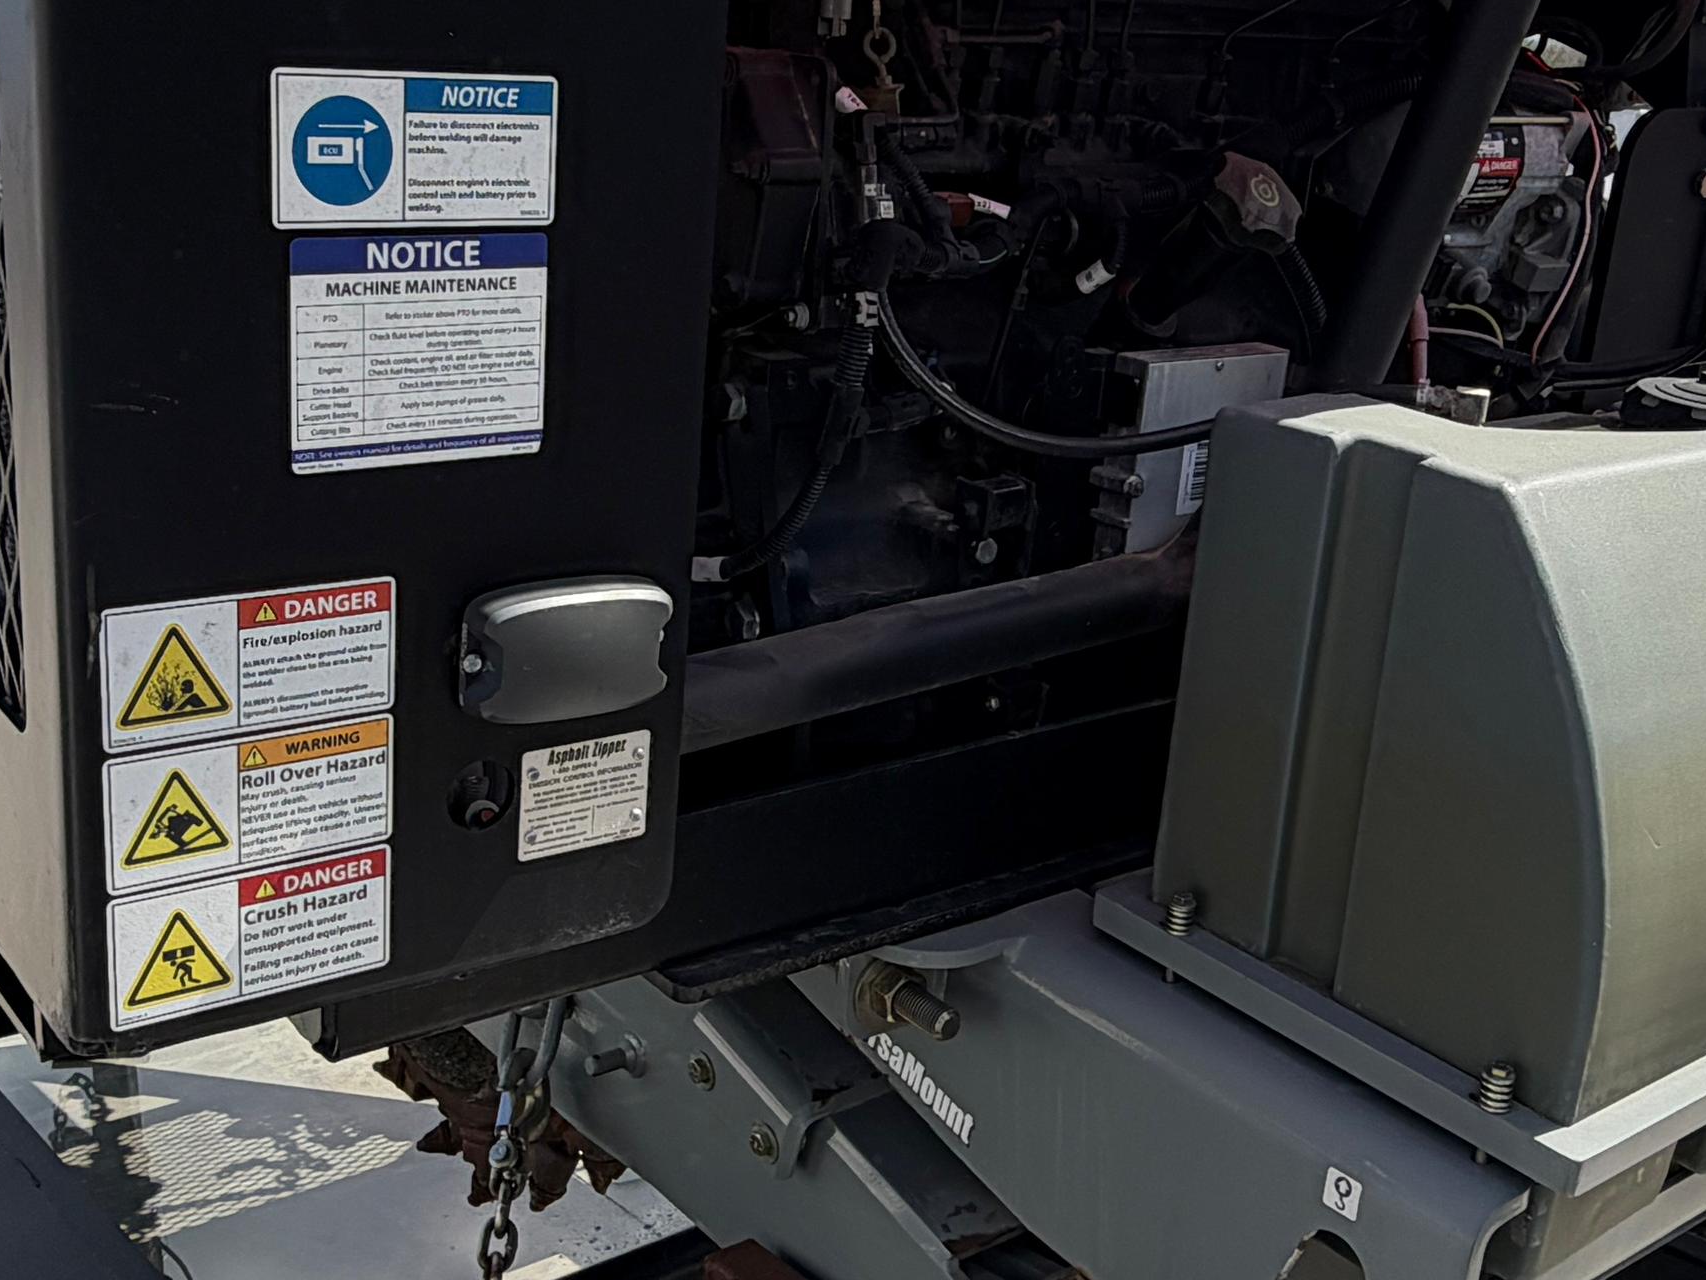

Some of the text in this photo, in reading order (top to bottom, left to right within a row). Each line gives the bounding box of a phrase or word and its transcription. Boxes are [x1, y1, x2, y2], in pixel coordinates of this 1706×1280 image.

[440, 85, 520, 108] NOTICE
[408, 119, 539, 131] Failure to disconnect electronics
[322, 146, 338, 154] ECU
[407, 132, 522, 144] before welding will damage
[407, 144, 447, 154] machine.
[1491, 160, 1518, 170] DANGER
[407, 177, 530, 188] Disconnect engine's electronic
[407, 189, 537, 200] control unit and battery prior to
[407, 202, 444, 214] welding.
[366, 239, 480, 269] NOTICE
[325, 275, 517, 297] MACHINE MAINTENANCE
[284, 589, 377, 619] DANGER
[242, 619, 382, 649] Fire/explosion hazard
[284, 730, 360, 755] WARNING
[546, 738, 627, 767] Asphalt Zipper
[241, 749, 386, 790] Roll Over Hazard
[562, 770, 594, 783] CONTROL
[283, 858, 372, 893] DANGER
[243, 883, 367, 925] Crush Hazard
[243, 911, 348, 942] Do NOT work under
[243, 918, 376, 956] unsupported equipment.
[243, 934, 379, 973] Falling machine can cause
[243, 950, 365, 986] serious injury or death.
